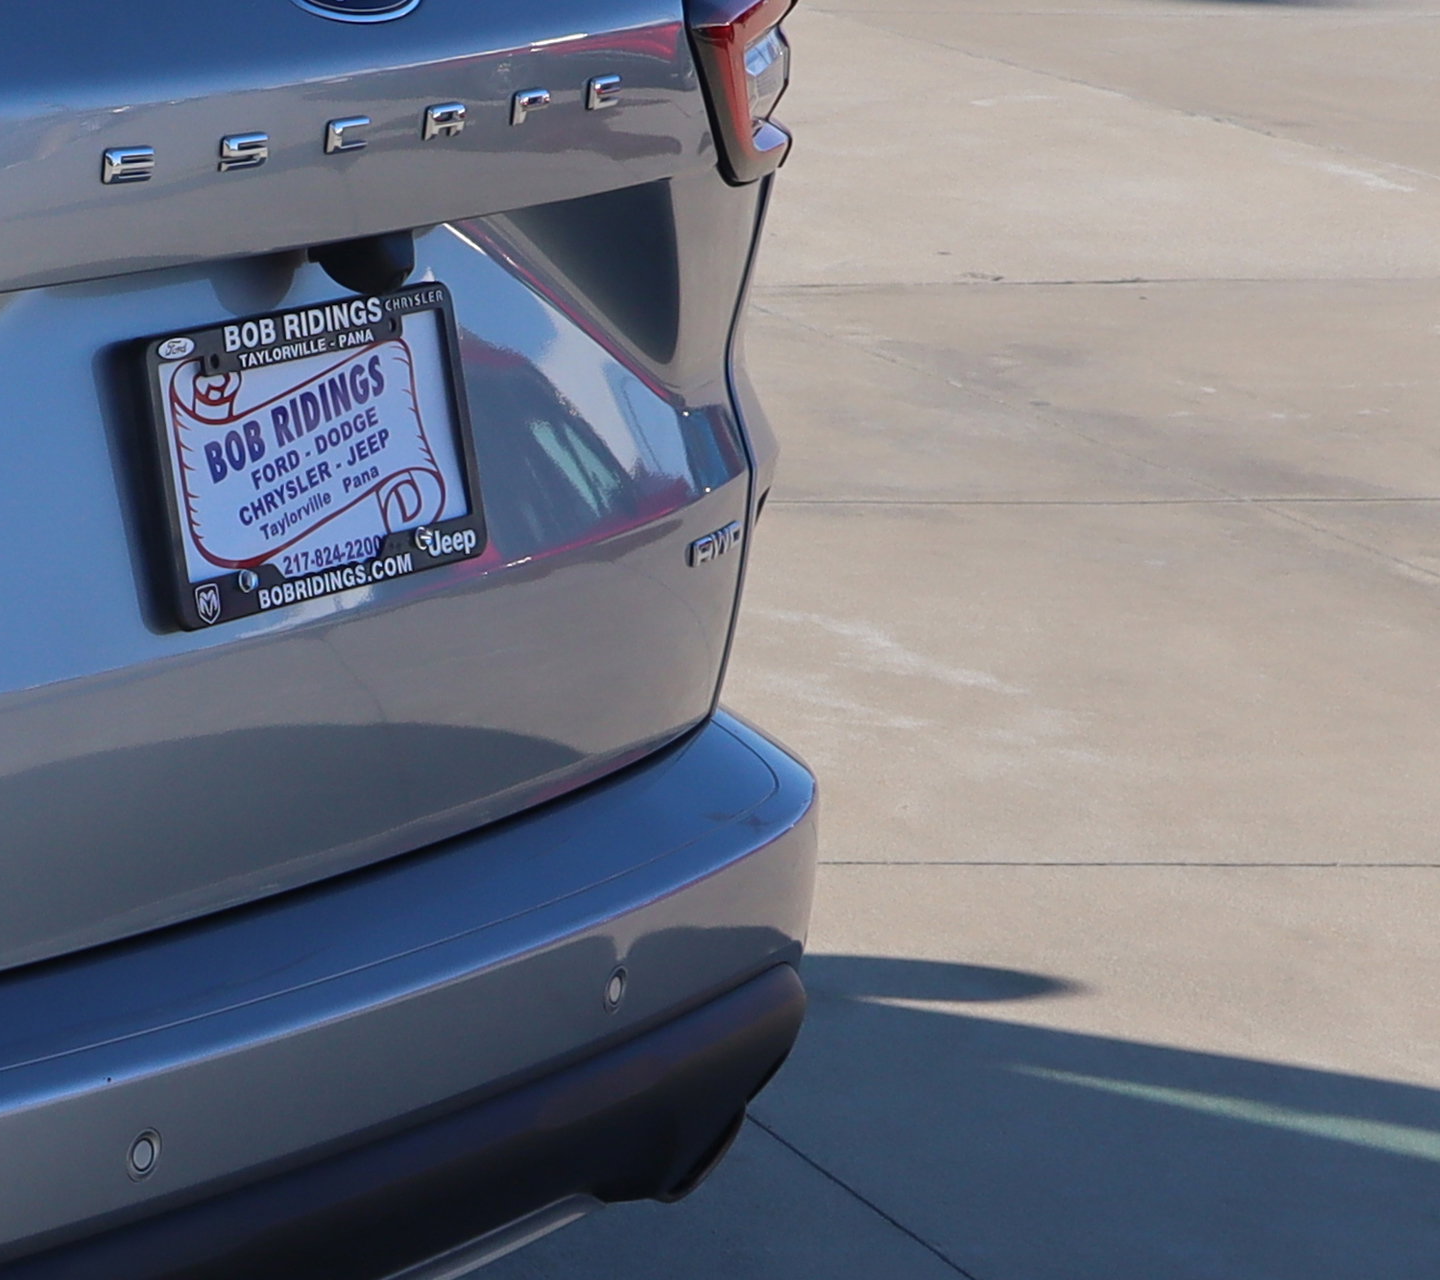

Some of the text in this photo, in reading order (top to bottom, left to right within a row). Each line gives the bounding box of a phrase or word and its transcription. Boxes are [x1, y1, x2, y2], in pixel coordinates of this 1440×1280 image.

[101, 74, 622, 185] ESCAPE
[223, 297, 382, 352] BOB RIDINGS
[384, 290, 444, 312] CHRYSLER
[163, 340, 188, 356] Ford
[238, 339, 327, 368] TAYLORVILLE
[339, 328, 374, 350] PANA
[204, 355, 385, 484] BOB RIDINGS
[251, 449, 300, 490] FORD
[314, 406, 379, 448] DODGE
[239, 460, 332, 525] CHRYSLER
[347, 428, 390, 467] JEEP
[260, 465, 380, 540] Taylorville Pana
[284, 535, 381, 575] 217-824-2200
[428, 529, 476, 557] Jeep
[259, 553, 413, 610] BOBRIDINGS.COM
